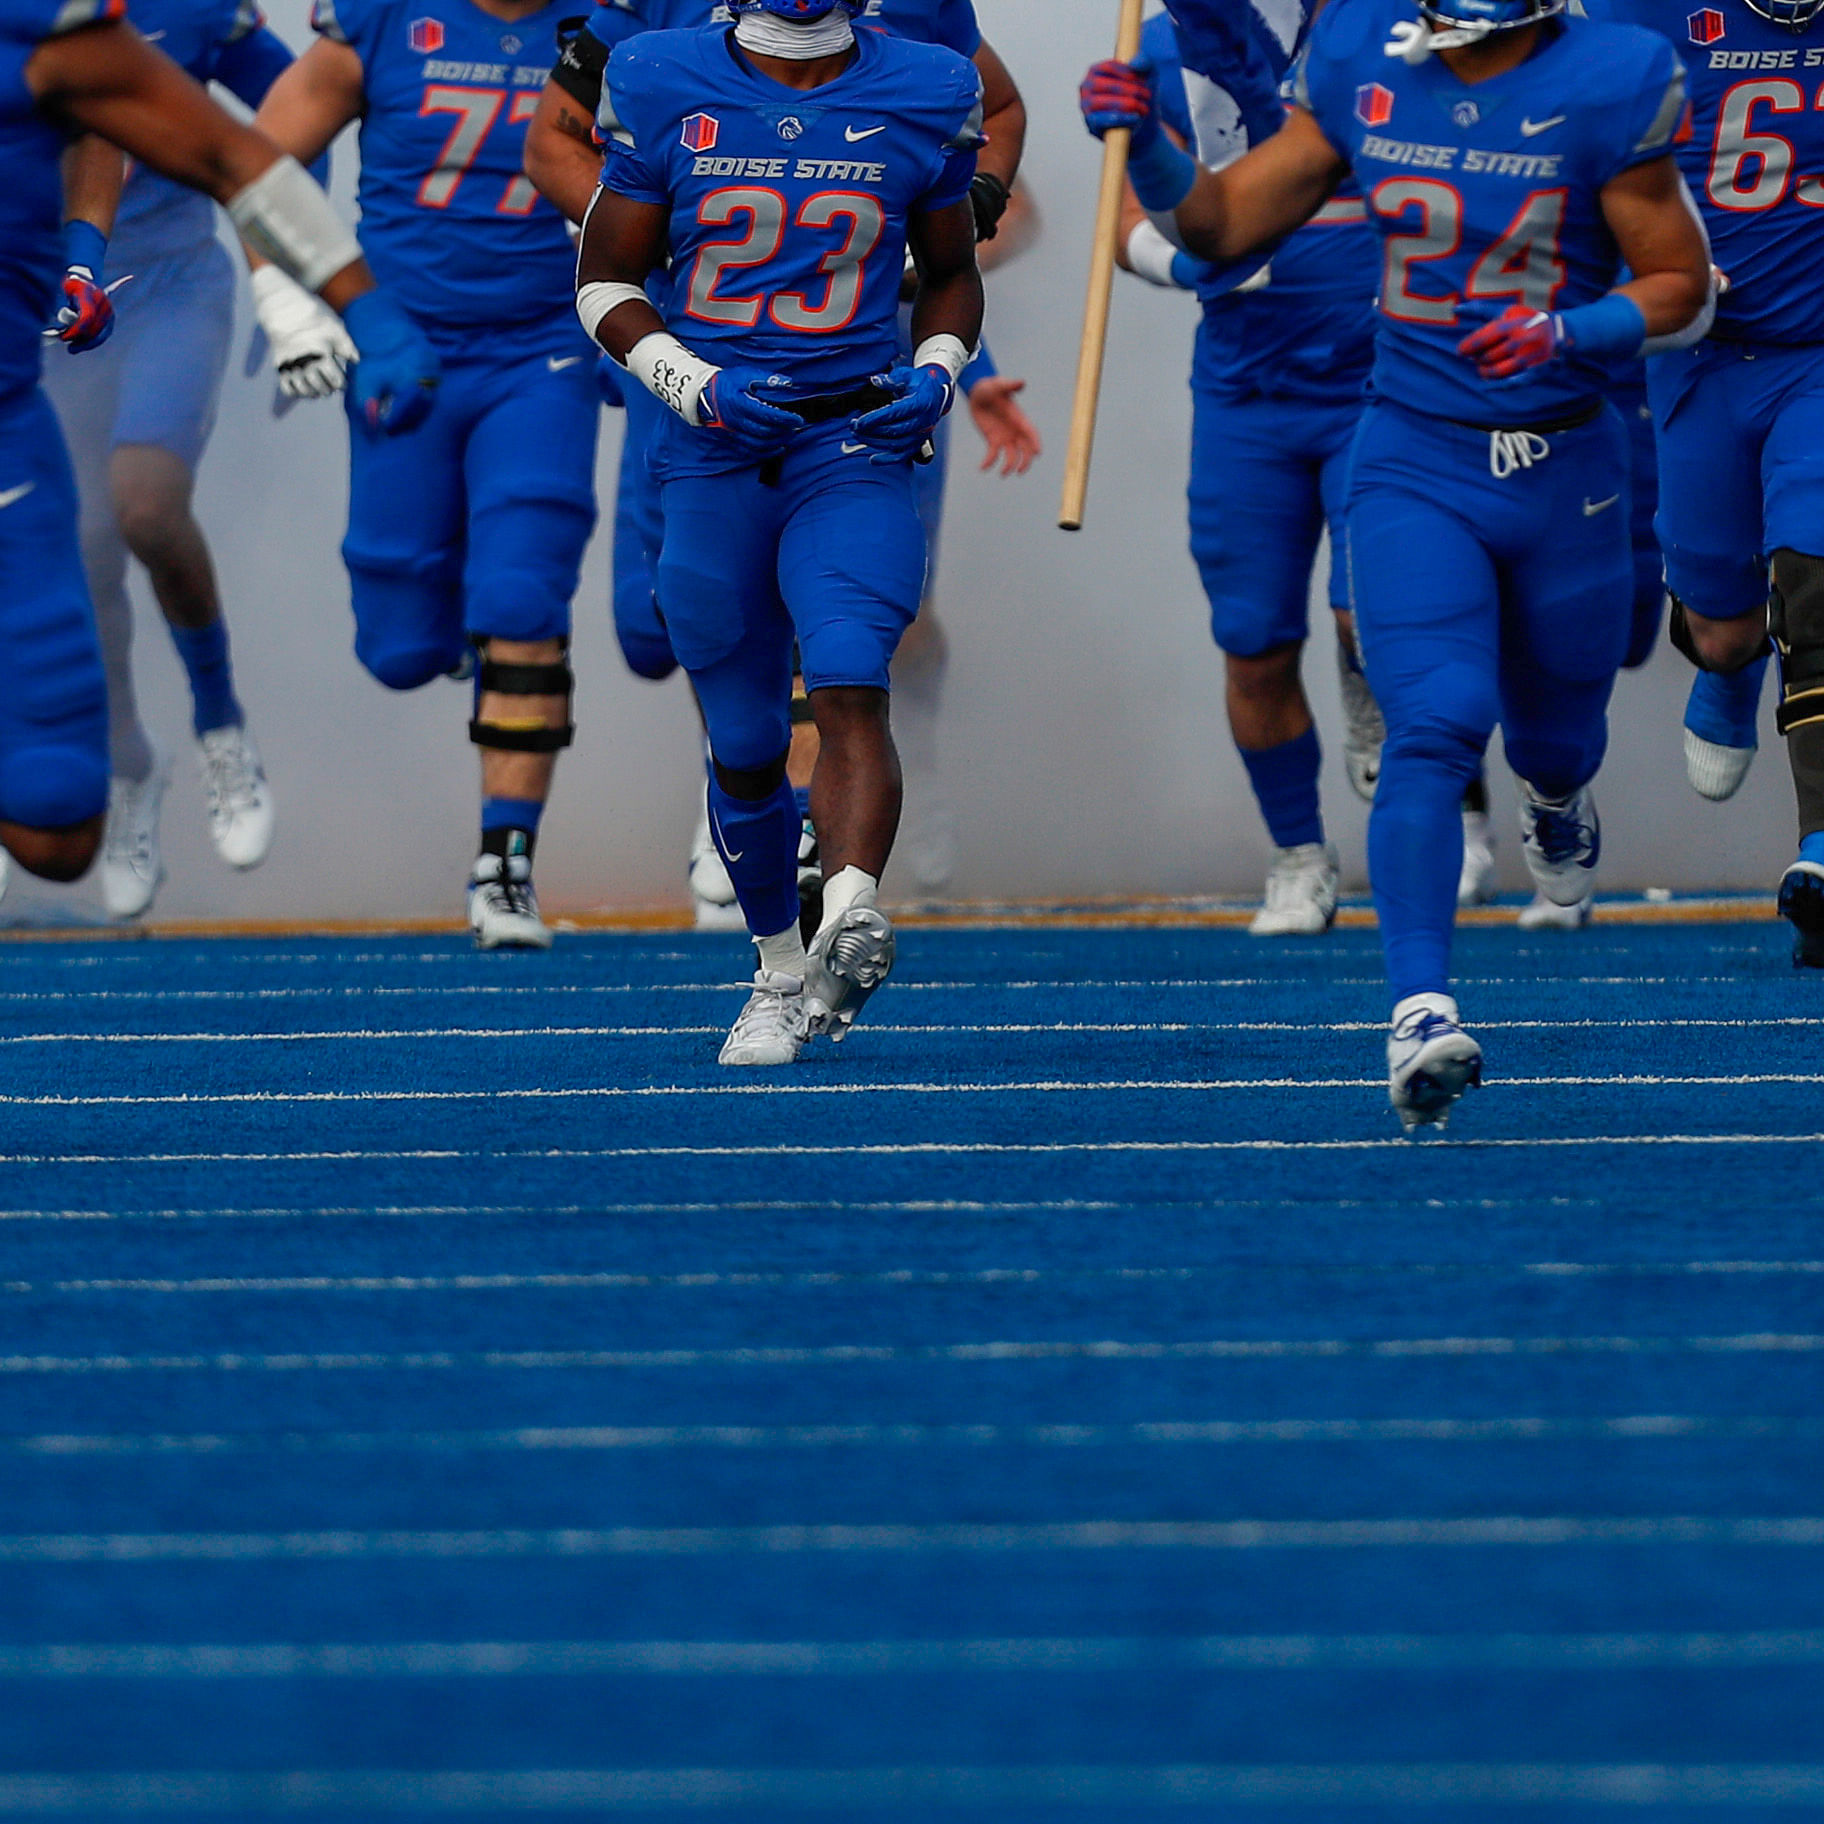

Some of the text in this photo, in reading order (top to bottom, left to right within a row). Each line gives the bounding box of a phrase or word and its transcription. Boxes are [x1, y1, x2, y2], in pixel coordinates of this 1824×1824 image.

[422, 59, 510, 84] BOISE
[1708, 49, 1800, 69] BOISE
[690, 156, 888, 182] BOISE STATE
[1361, 134, 1564, 178] BOISE STATE
[684, 185, 887, 334] 23
[1371, 174, 1569, 325] 24
